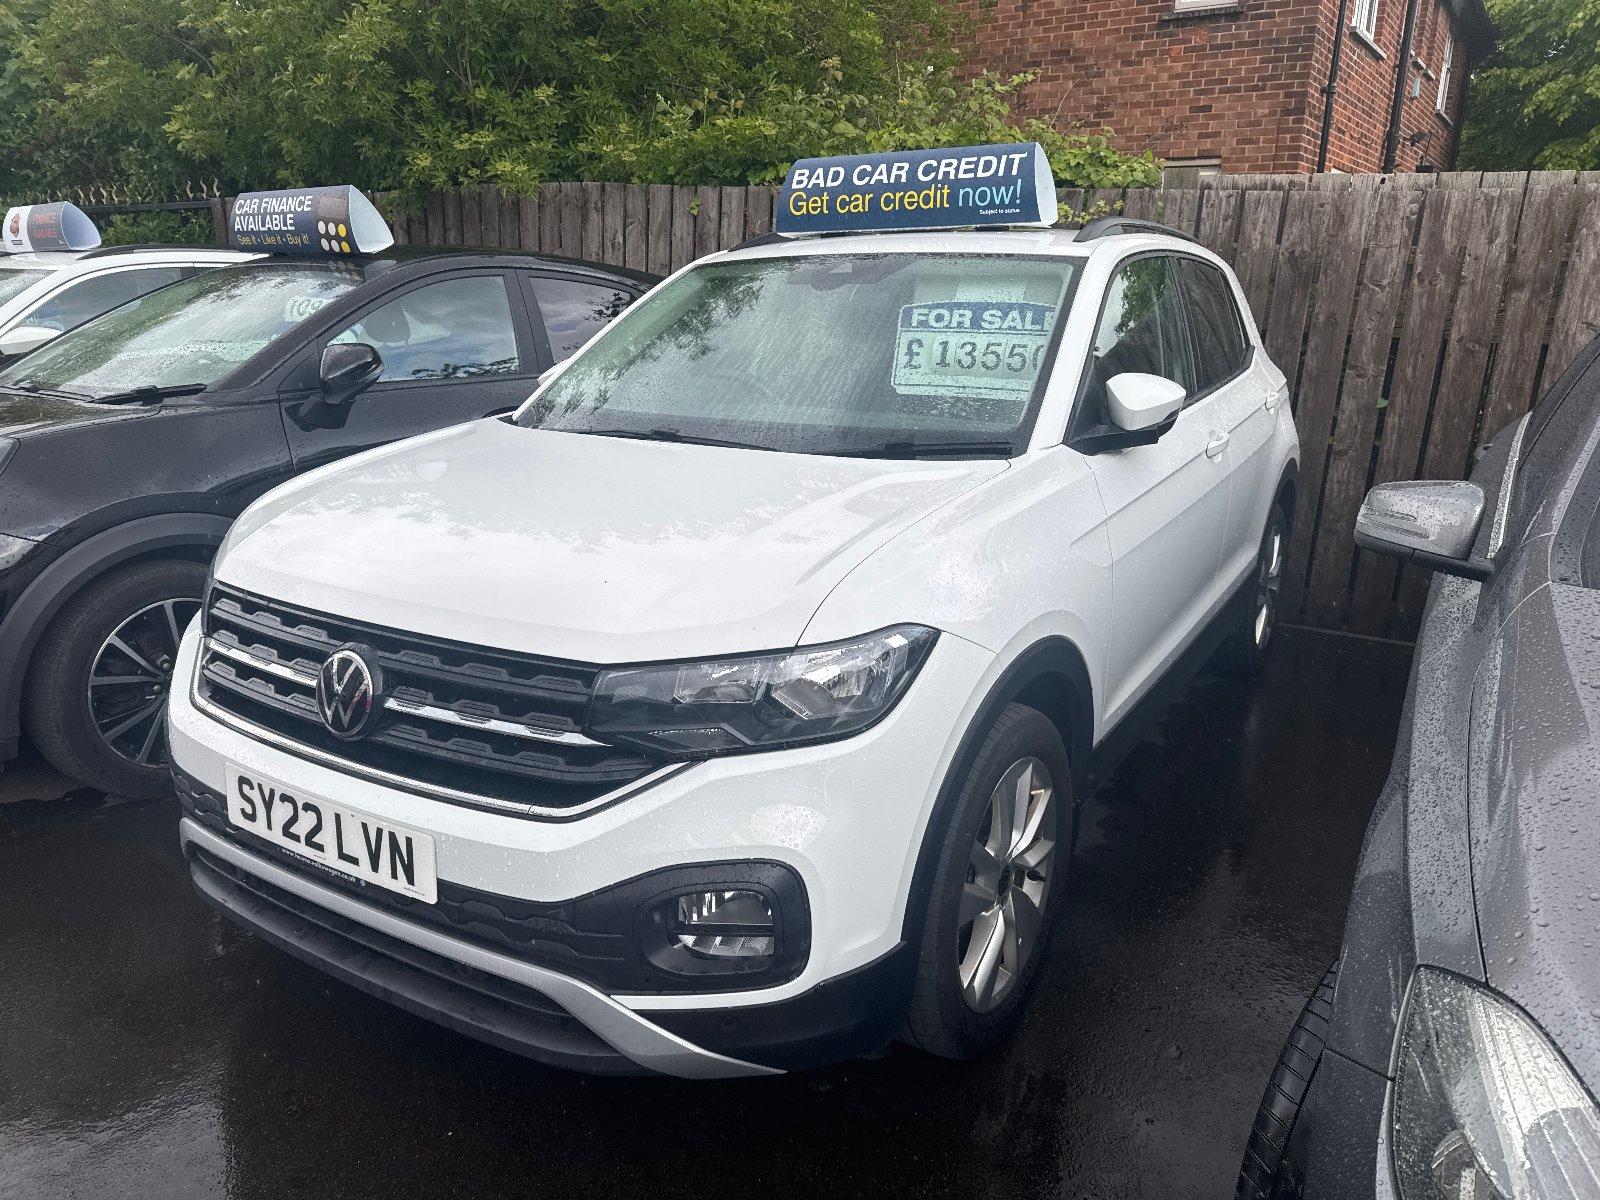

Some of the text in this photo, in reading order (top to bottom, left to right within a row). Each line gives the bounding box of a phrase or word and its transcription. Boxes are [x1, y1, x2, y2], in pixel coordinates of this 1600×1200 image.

[791, 152, 1028, 189] BAD CAR CREDIT
[234, 195, 314, 214] CAR FINANCE
[789, 178, 1022, 216] Get car credit now!
[234, 213, 296, 232] AVAILABLE
[911, 308, 973, 328] FOR
[237, 775, 415, 886] SY22 LVN
